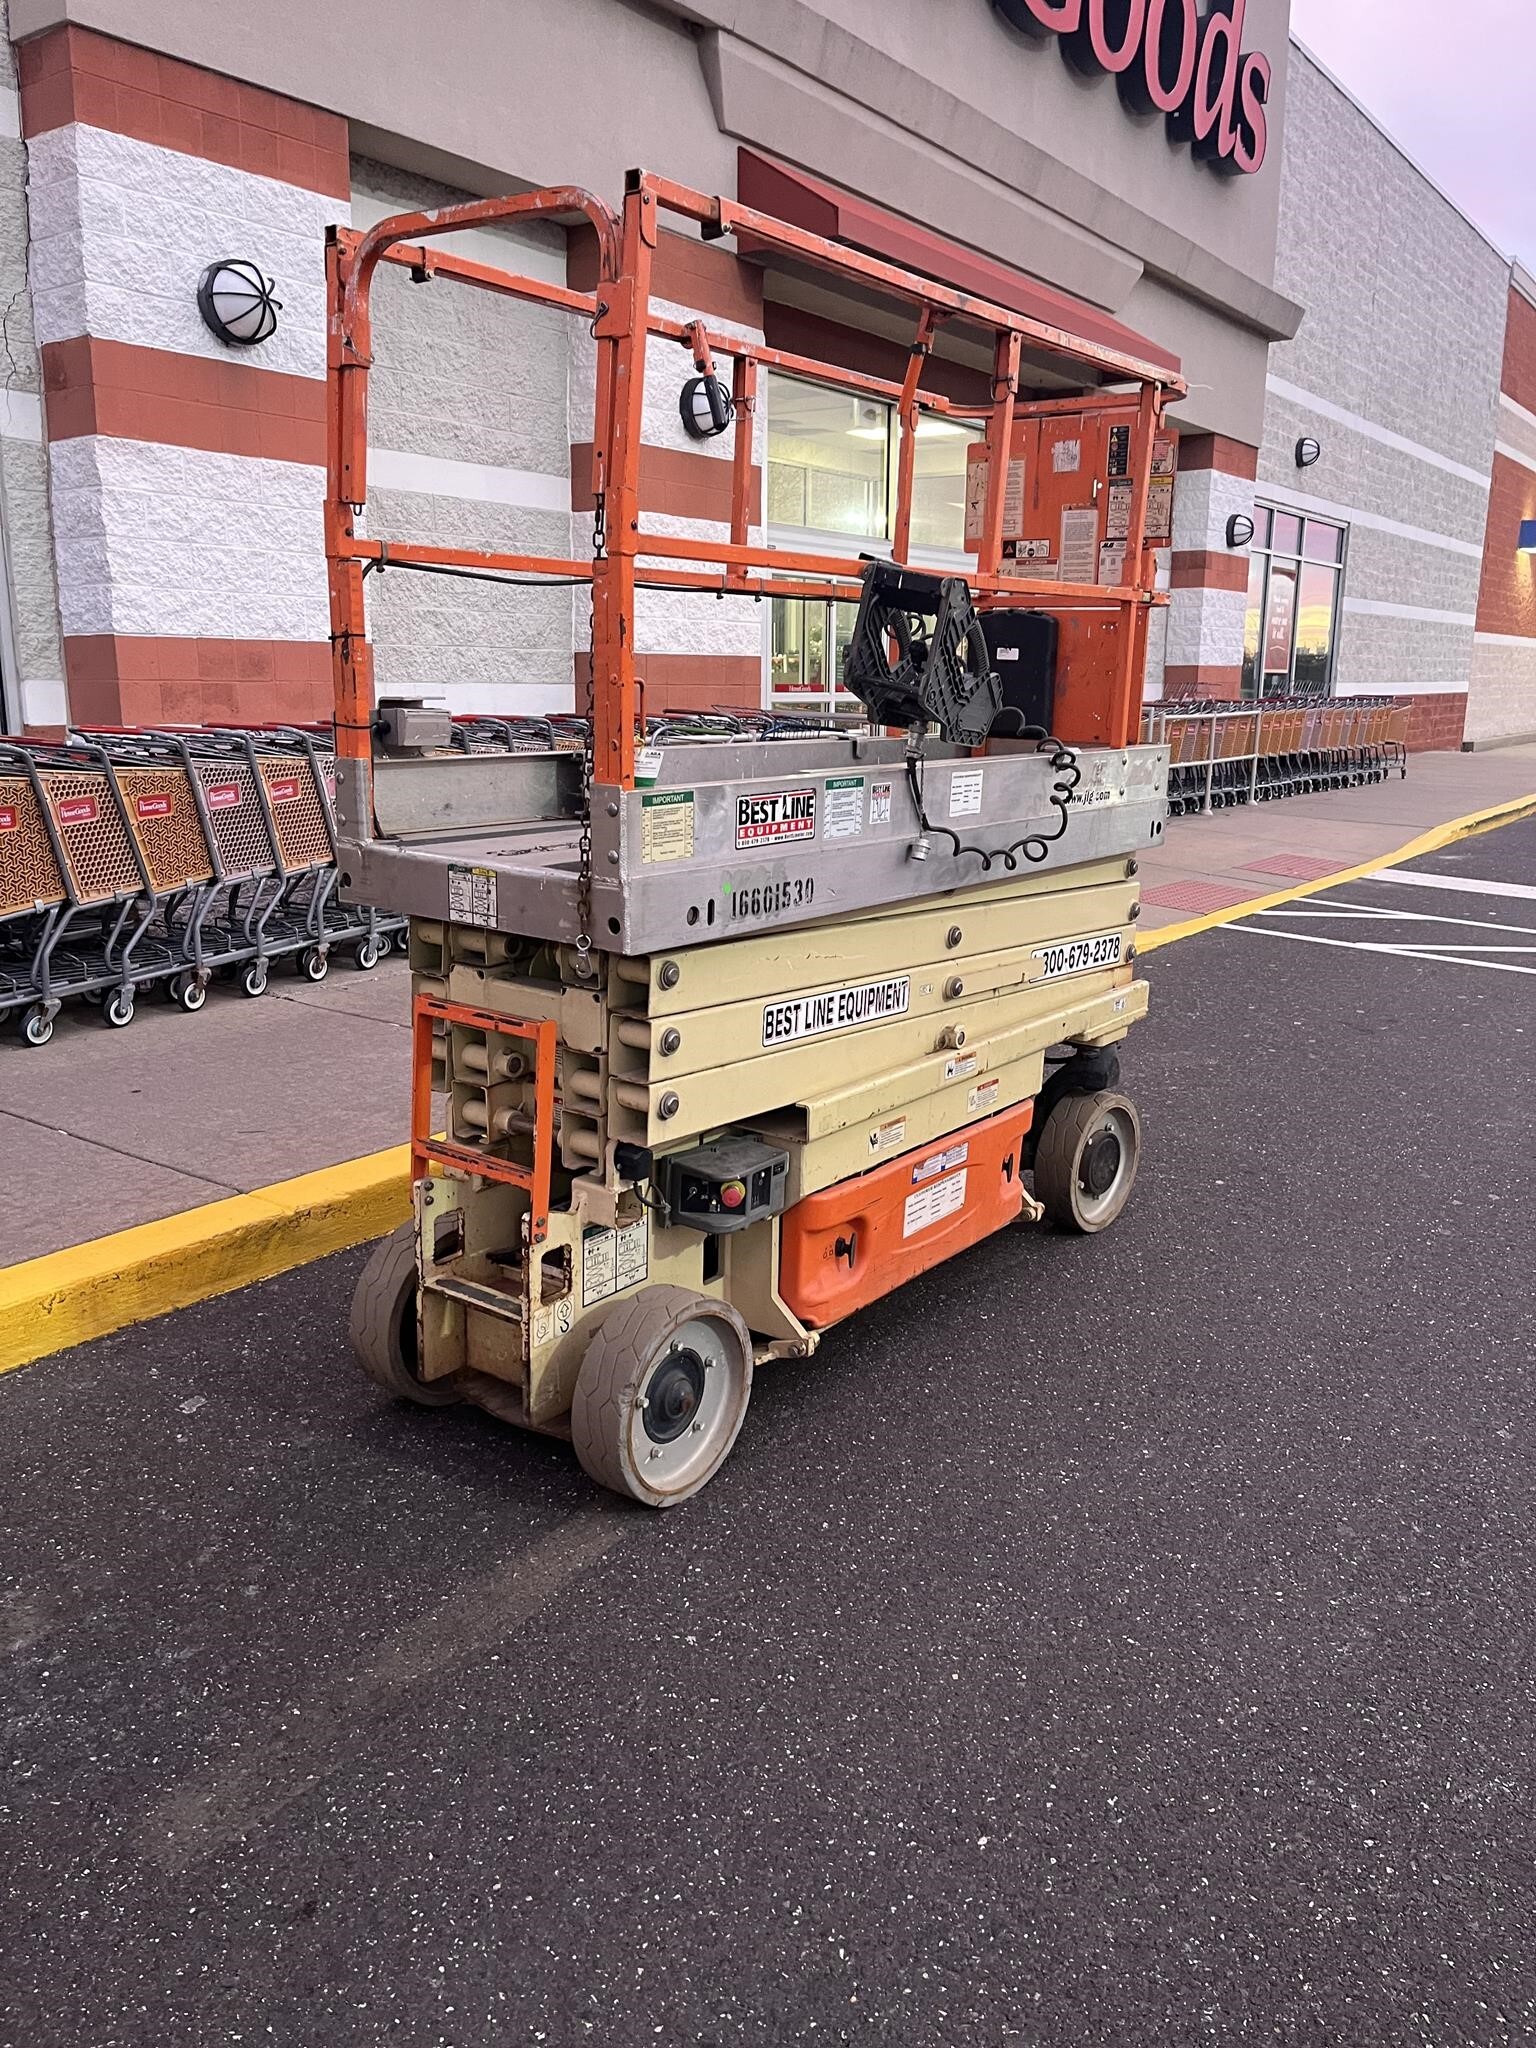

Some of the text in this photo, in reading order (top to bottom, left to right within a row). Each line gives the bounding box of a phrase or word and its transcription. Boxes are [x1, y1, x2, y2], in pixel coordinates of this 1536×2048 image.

[1025, 0, 1272, 174] oods
[652, 794, 685, 804] IMPORTANT
[738, 798, 778, 826] BEST
[782, 795, 814, 820] LINE
[739, 820, 812, 838] EQUIPMENT
[731, 877, 815, 919] 16601530
[765, 980, 909, 1040] BEST LINE EQUIPMENT
